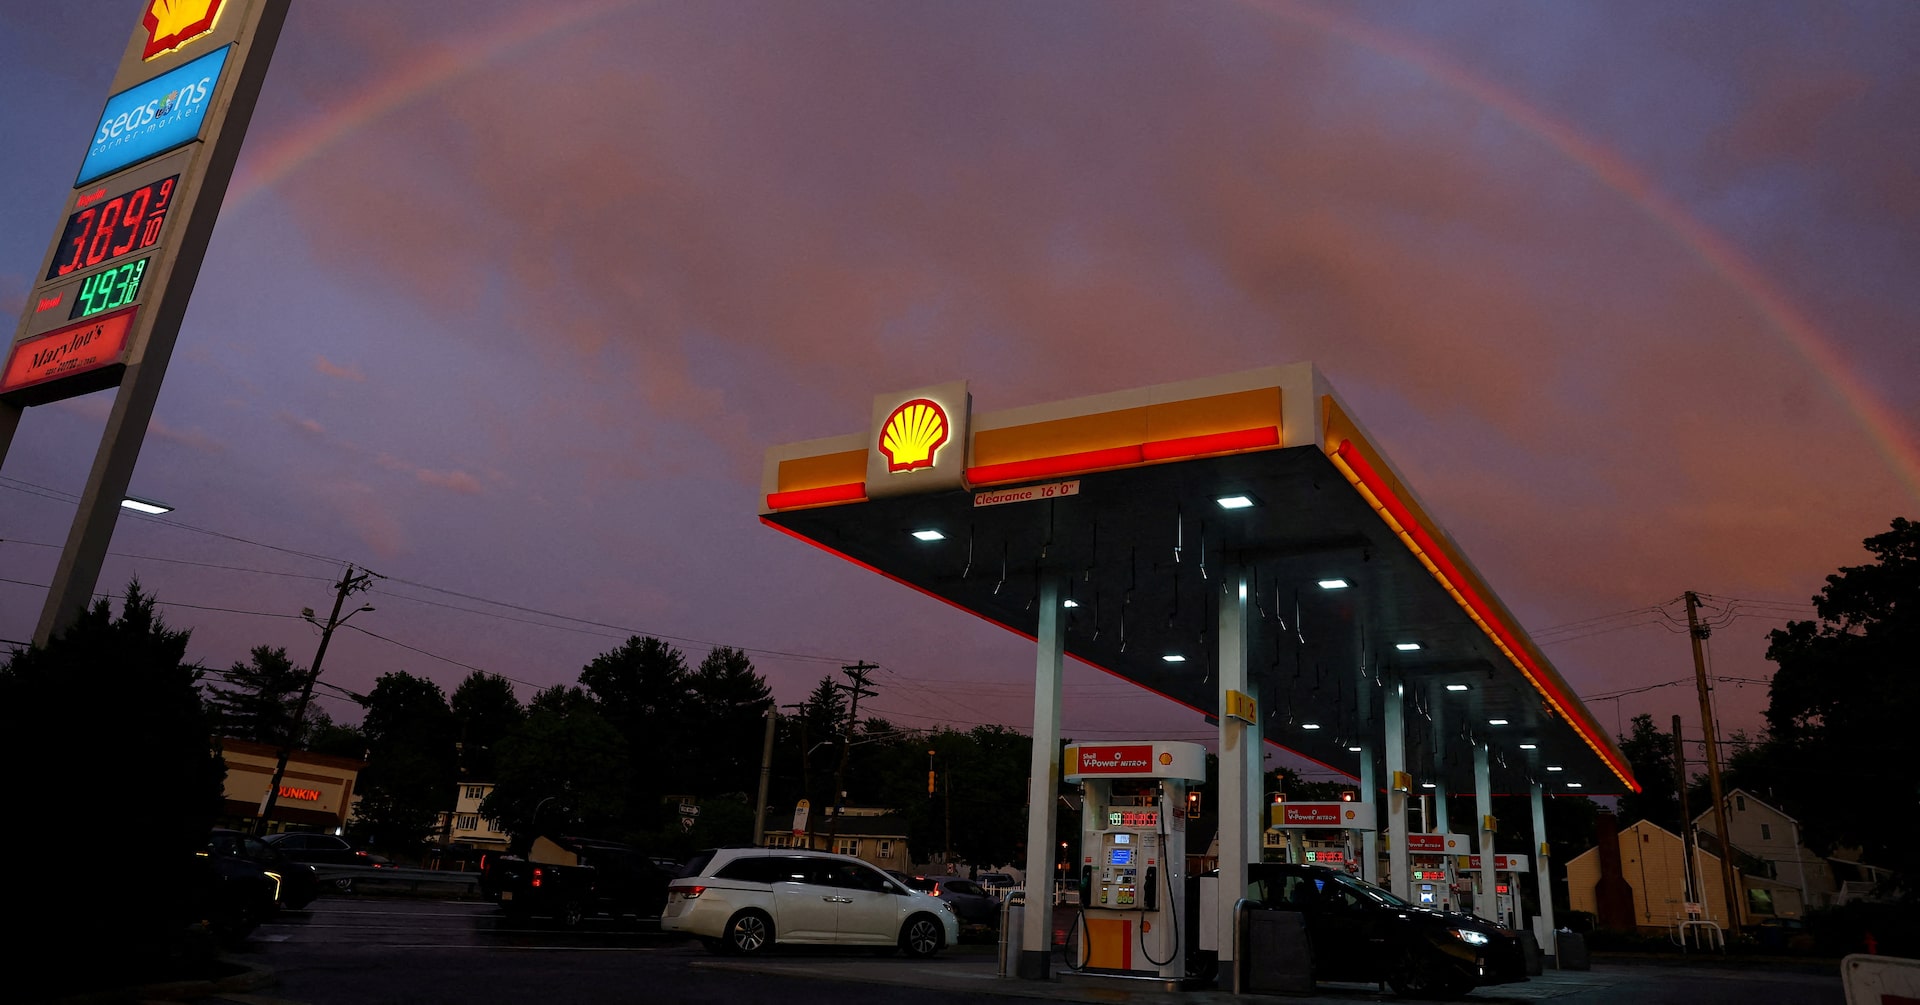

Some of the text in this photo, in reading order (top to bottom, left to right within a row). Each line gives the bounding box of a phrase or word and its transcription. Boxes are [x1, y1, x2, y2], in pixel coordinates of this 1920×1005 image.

[27, 324, 104, 373] Marylou's
[975, 491, 1032, 505] Clearance
[1249, 702, 1255, 719] 2
[1083, 759, 1118, 767] V-Power
